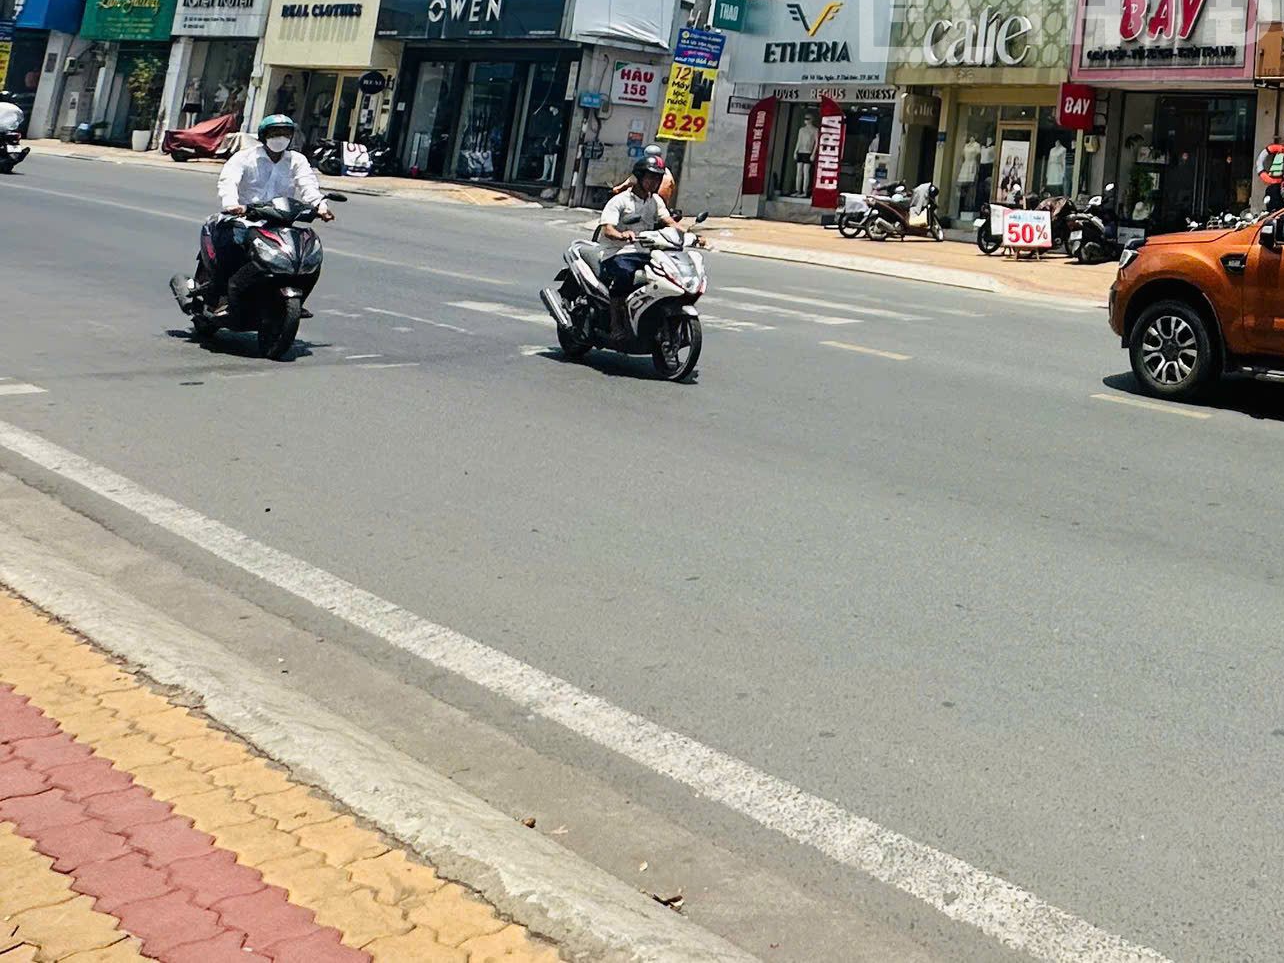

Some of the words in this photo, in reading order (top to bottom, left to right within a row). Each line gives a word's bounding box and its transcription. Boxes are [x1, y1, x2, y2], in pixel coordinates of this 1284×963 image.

[281, 4, 309, 18] REAL
[311, 3, 362, 17] CLOTHES
[720, 3, 739, 22] THAO
[763, 40, 851, 64] ETHERIA
[623, 83, 647, 96] 158
[671, 80, 690, 90] Máy
[1064, 97, 1090, 116] BAY
[814, 115, 843, 190] ETHERIA
[1008, 223, 1048, 244] 50%
